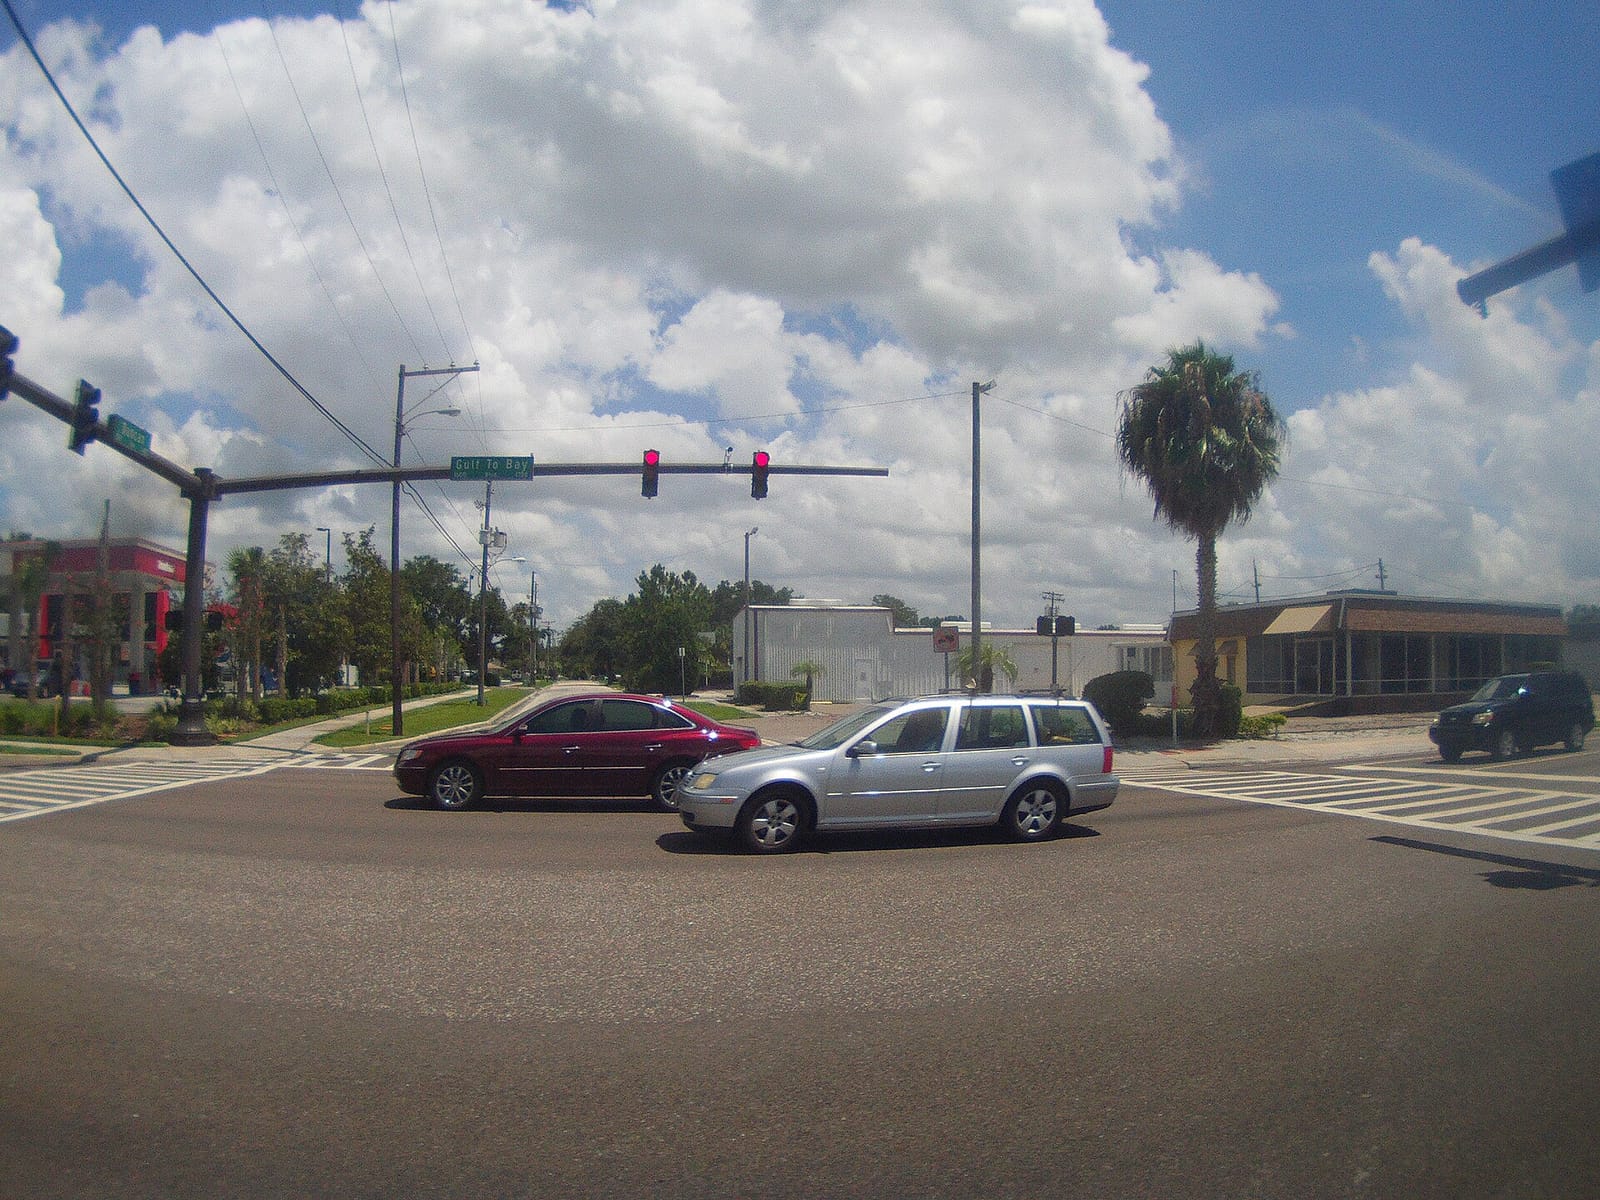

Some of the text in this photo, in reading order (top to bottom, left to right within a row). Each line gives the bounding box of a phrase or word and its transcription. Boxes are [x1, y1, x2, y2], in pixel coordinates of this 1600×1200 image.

[456, 458, 528, 472] Gulf To Bay
